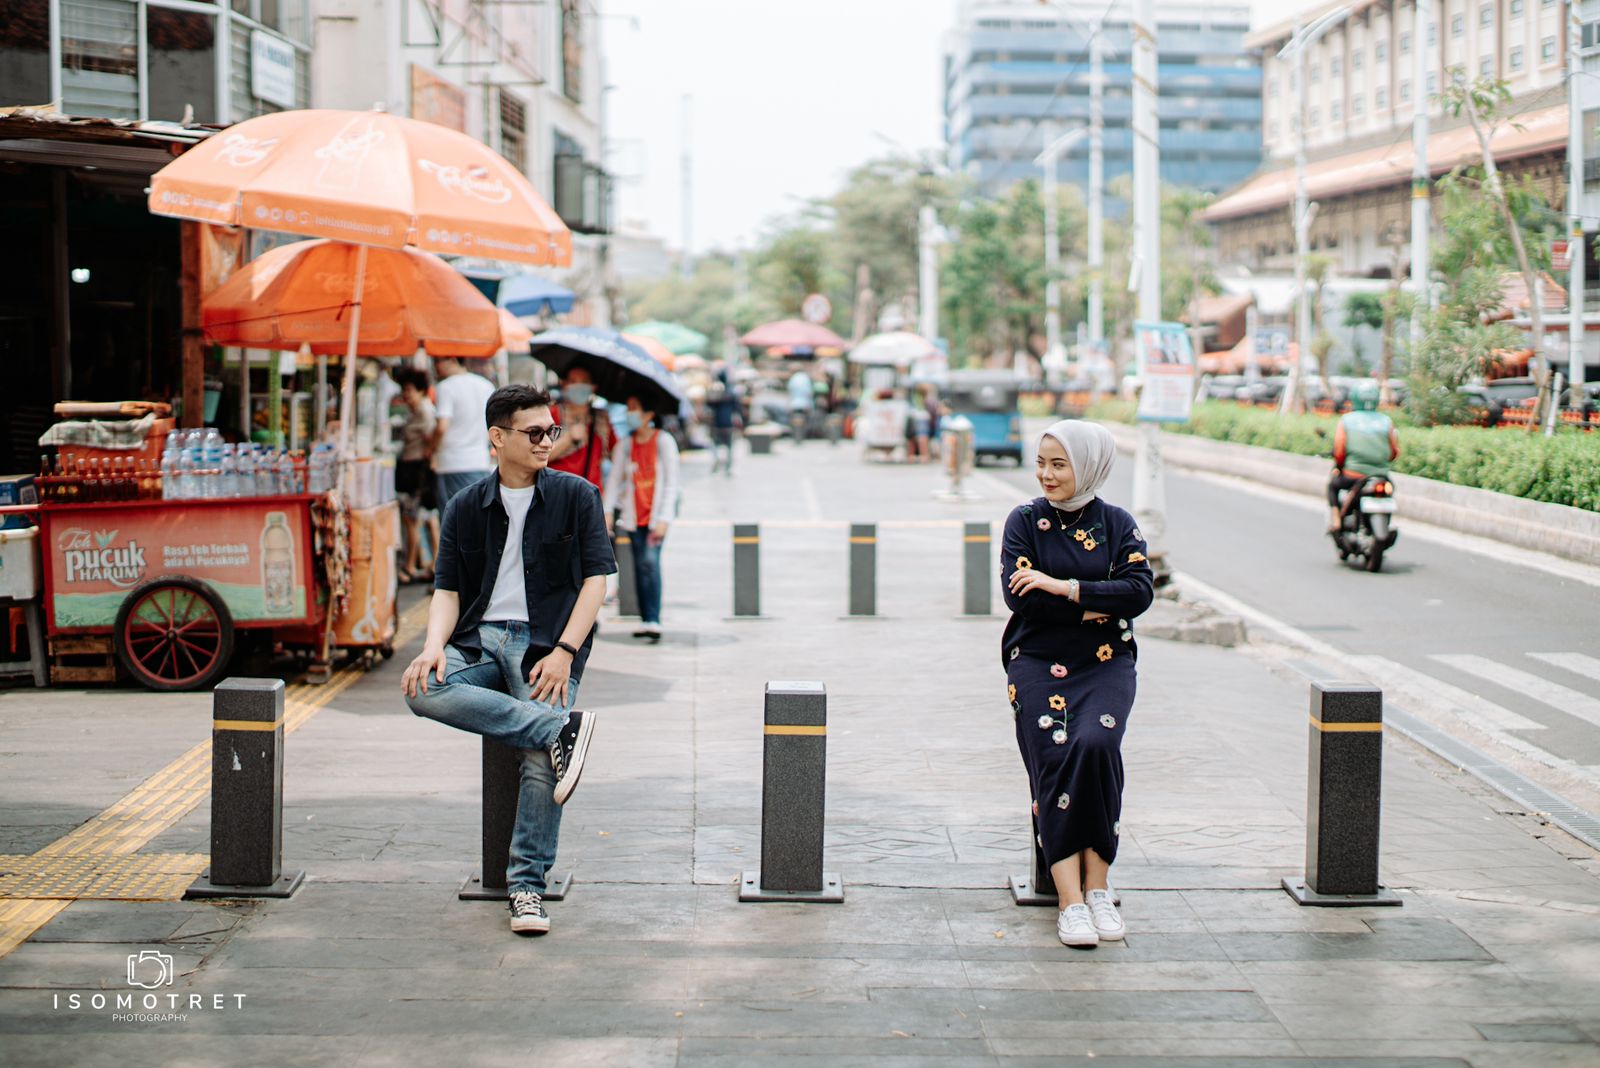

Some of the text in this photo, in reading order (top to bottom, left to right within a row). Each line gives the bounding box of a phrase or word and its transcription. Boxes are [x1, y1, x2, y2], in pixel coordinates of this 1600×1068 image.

[57, 527, 92, 551] Teh
[163, 544, 189, 557] Rasa
[190, 543, 209, 556] Teh
[65, 539, 147, 583] pucuk
[79, 566, 139, 582] HARUM
